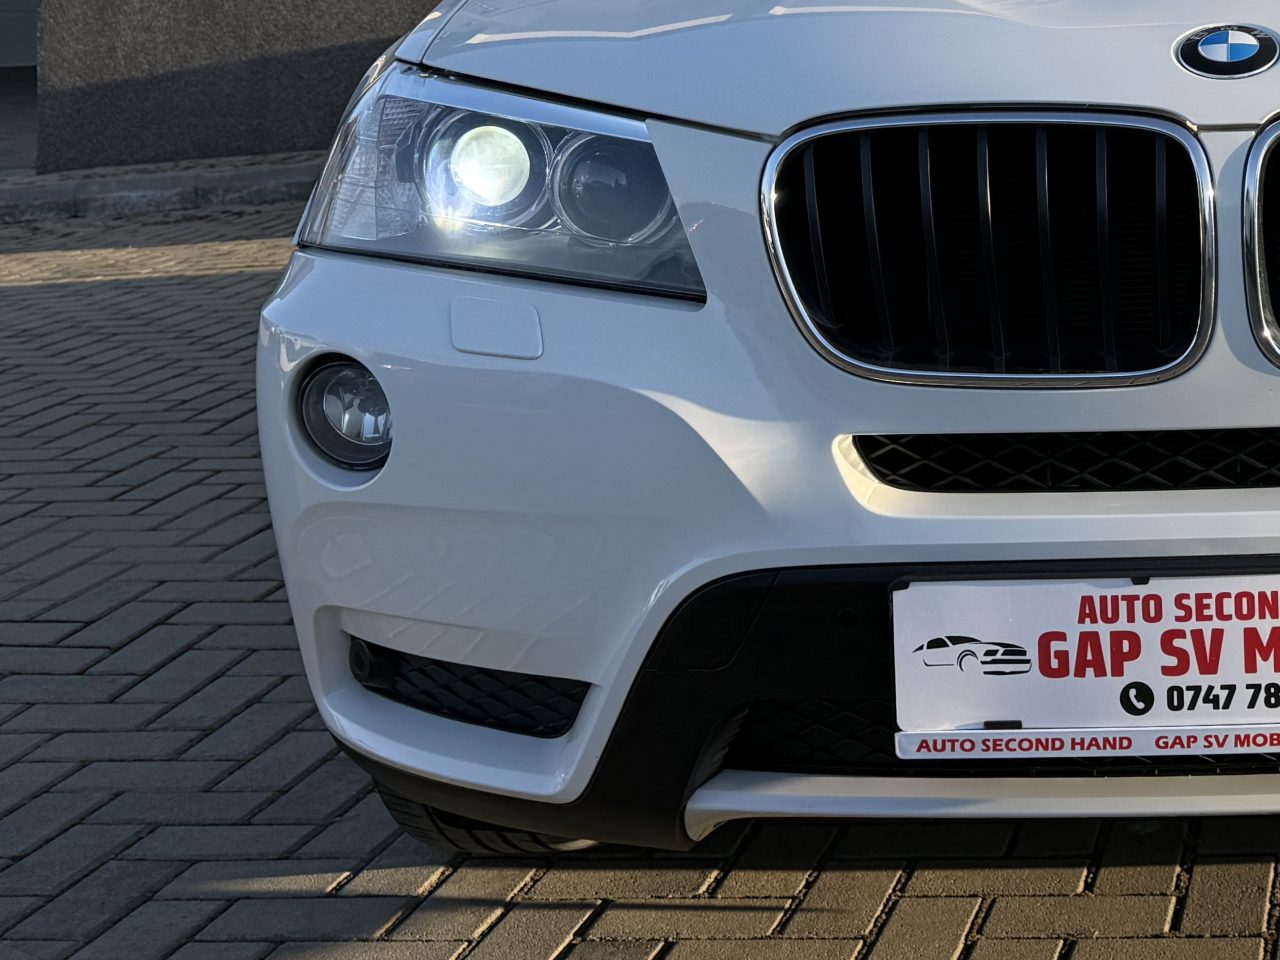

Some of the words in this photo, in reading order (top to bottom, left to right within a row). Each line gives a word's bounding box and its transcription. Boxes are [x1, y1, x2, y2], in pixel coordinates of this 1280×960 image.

[1077, 593, 1163, 625] AUTO
[1037, 630, 1142, 679] GAP
[1160, 628, 1225, 677] SV
[1166, 684, 1237, 712] 0747
[916, 738, 976, 754] AUTO
[981, 737, 1065, 753] SECOND
[1070, 735, 1133, 751] HAND
[1154, 735, 1198, 750] GAP
[1203, 734, 1229, 749] SV
